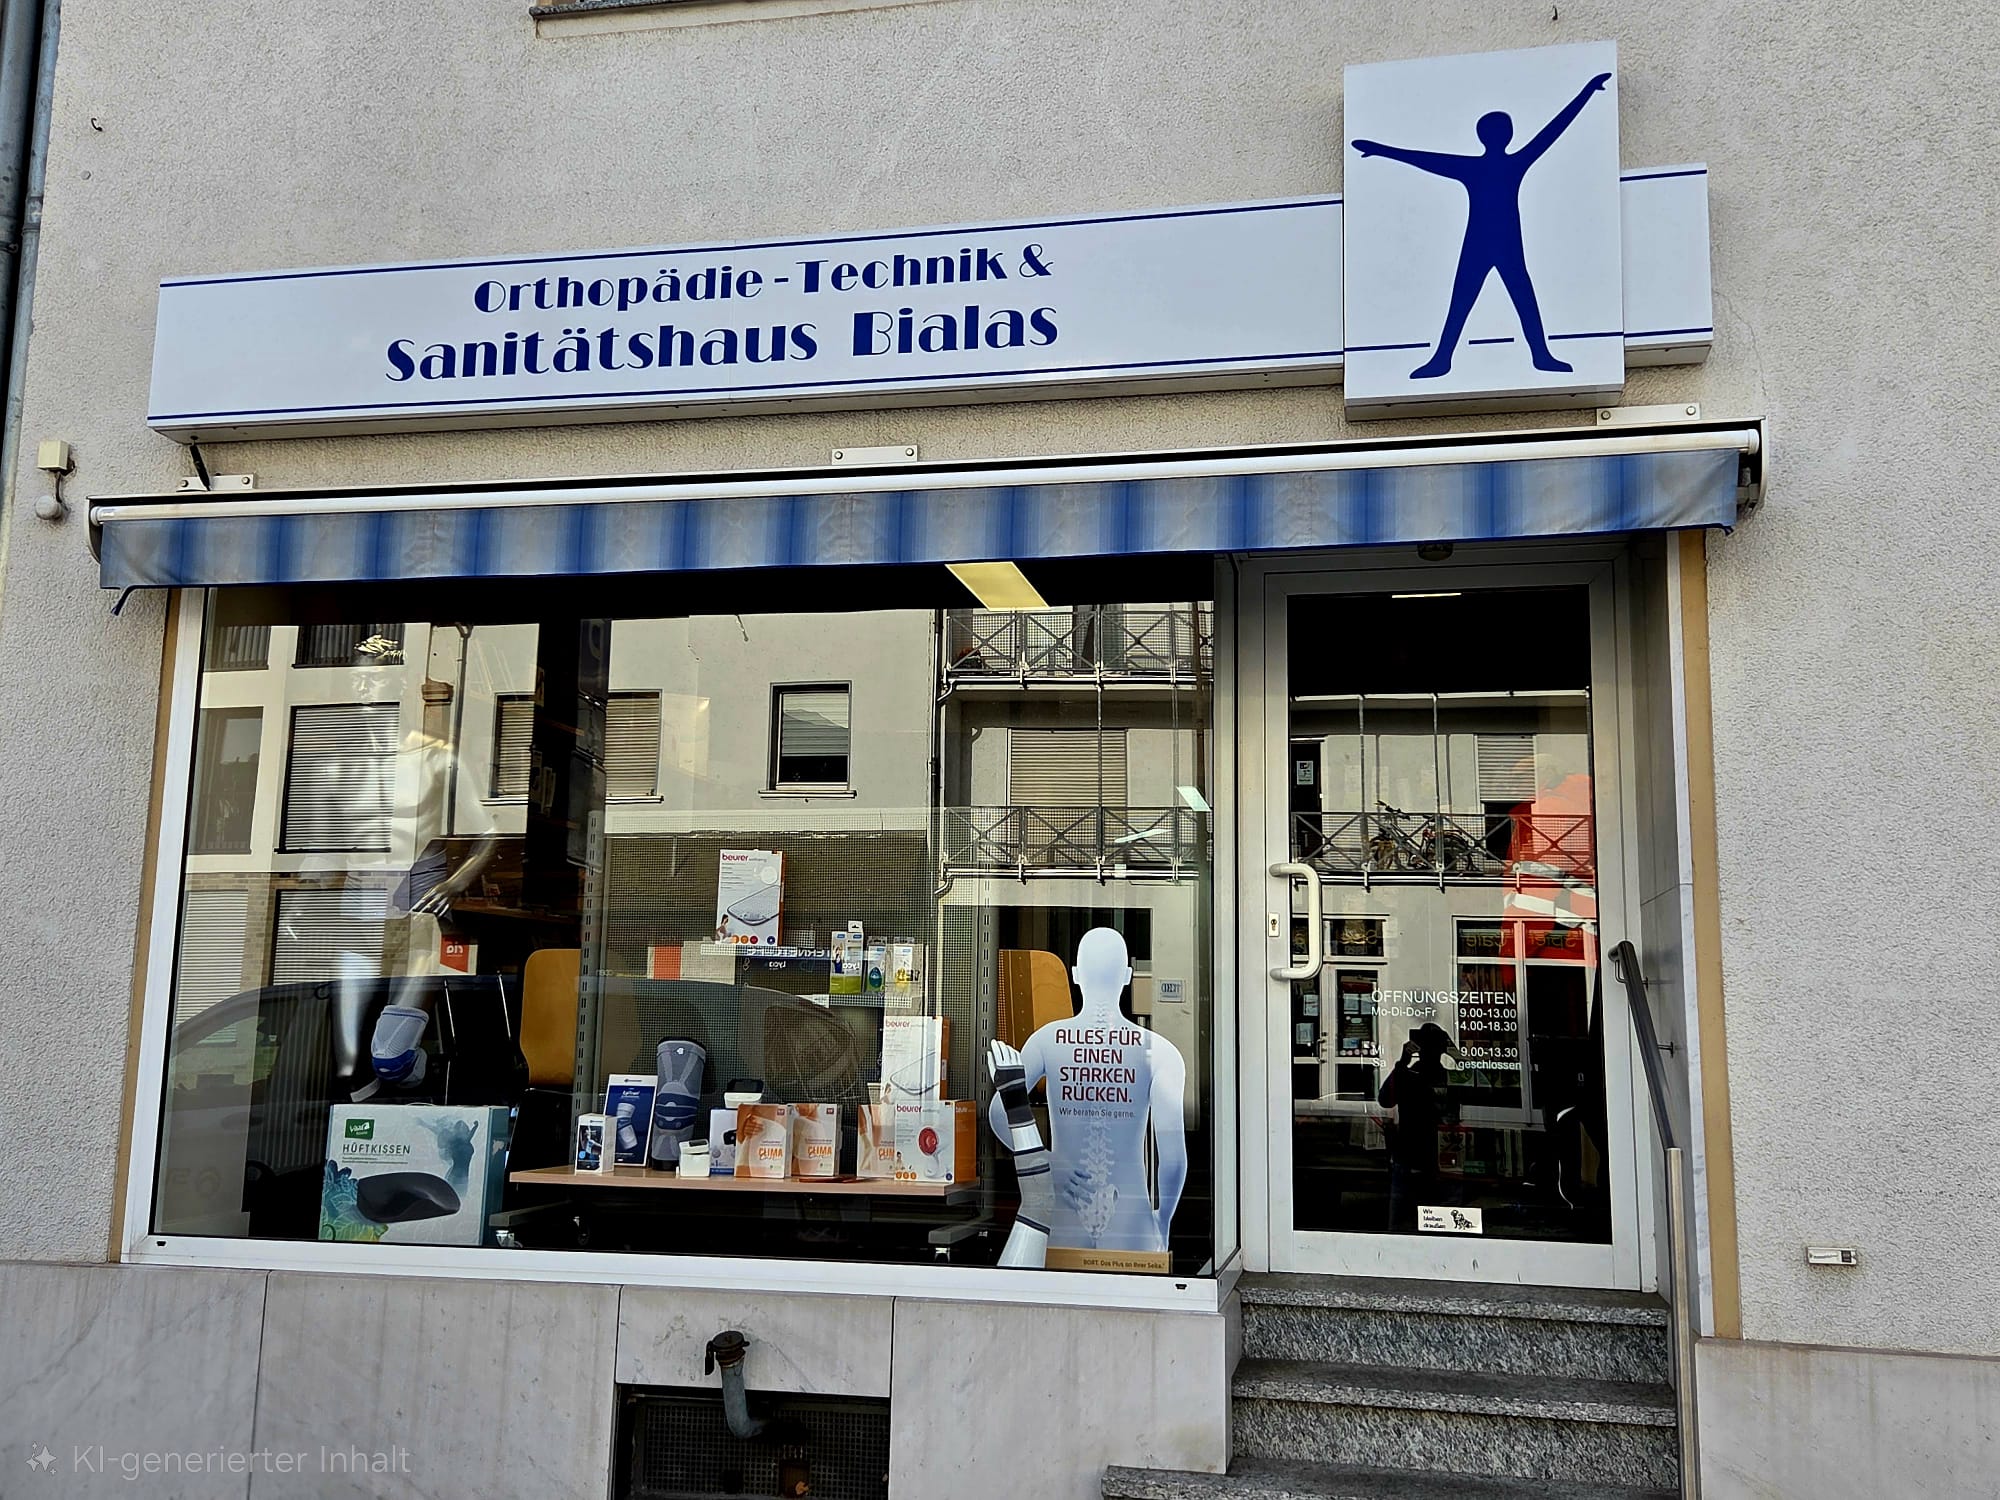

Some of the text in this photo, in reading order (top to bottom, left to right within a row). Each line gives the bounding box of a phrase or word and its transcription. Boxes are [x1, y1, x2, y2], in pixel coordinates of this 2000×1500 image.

[1018, 243, 1054, 278] &
[385, 304, 1058, 382] Sanitätshaus Bialas
[722, 853, 749, 861] beurer
[1371, 989, 1516, 1005] ÖFFNUNGSZEITEN
[1371, 1006, 1517, 1019] Mo-Di-Do-Fr 9.00-13.00
[885, 1019, 911, 1028] beurer
[1454, 1021, 1517, 1032] 14.00-18.30
[1055, 1027, 1142, 1046] ALLES FÜR
[1073, 1048, 1123, 1064] EINEN
[1372, 1045, 1518, 1058] Mi 9.00-13.30
[1372, 1058, 1522, 1071] Sa geschlossen
[1059, 1066, 1136, 1084] STARKEN
[1062, 1082, 1133, 1103] RÜCKEN.
[896, 1104, 922, 1113] beurer
[1059, 1107, 1136, 1119] Wir beraten Sie gerne.
[342, 1142, 411, 1155] HÜFTKISSEN
